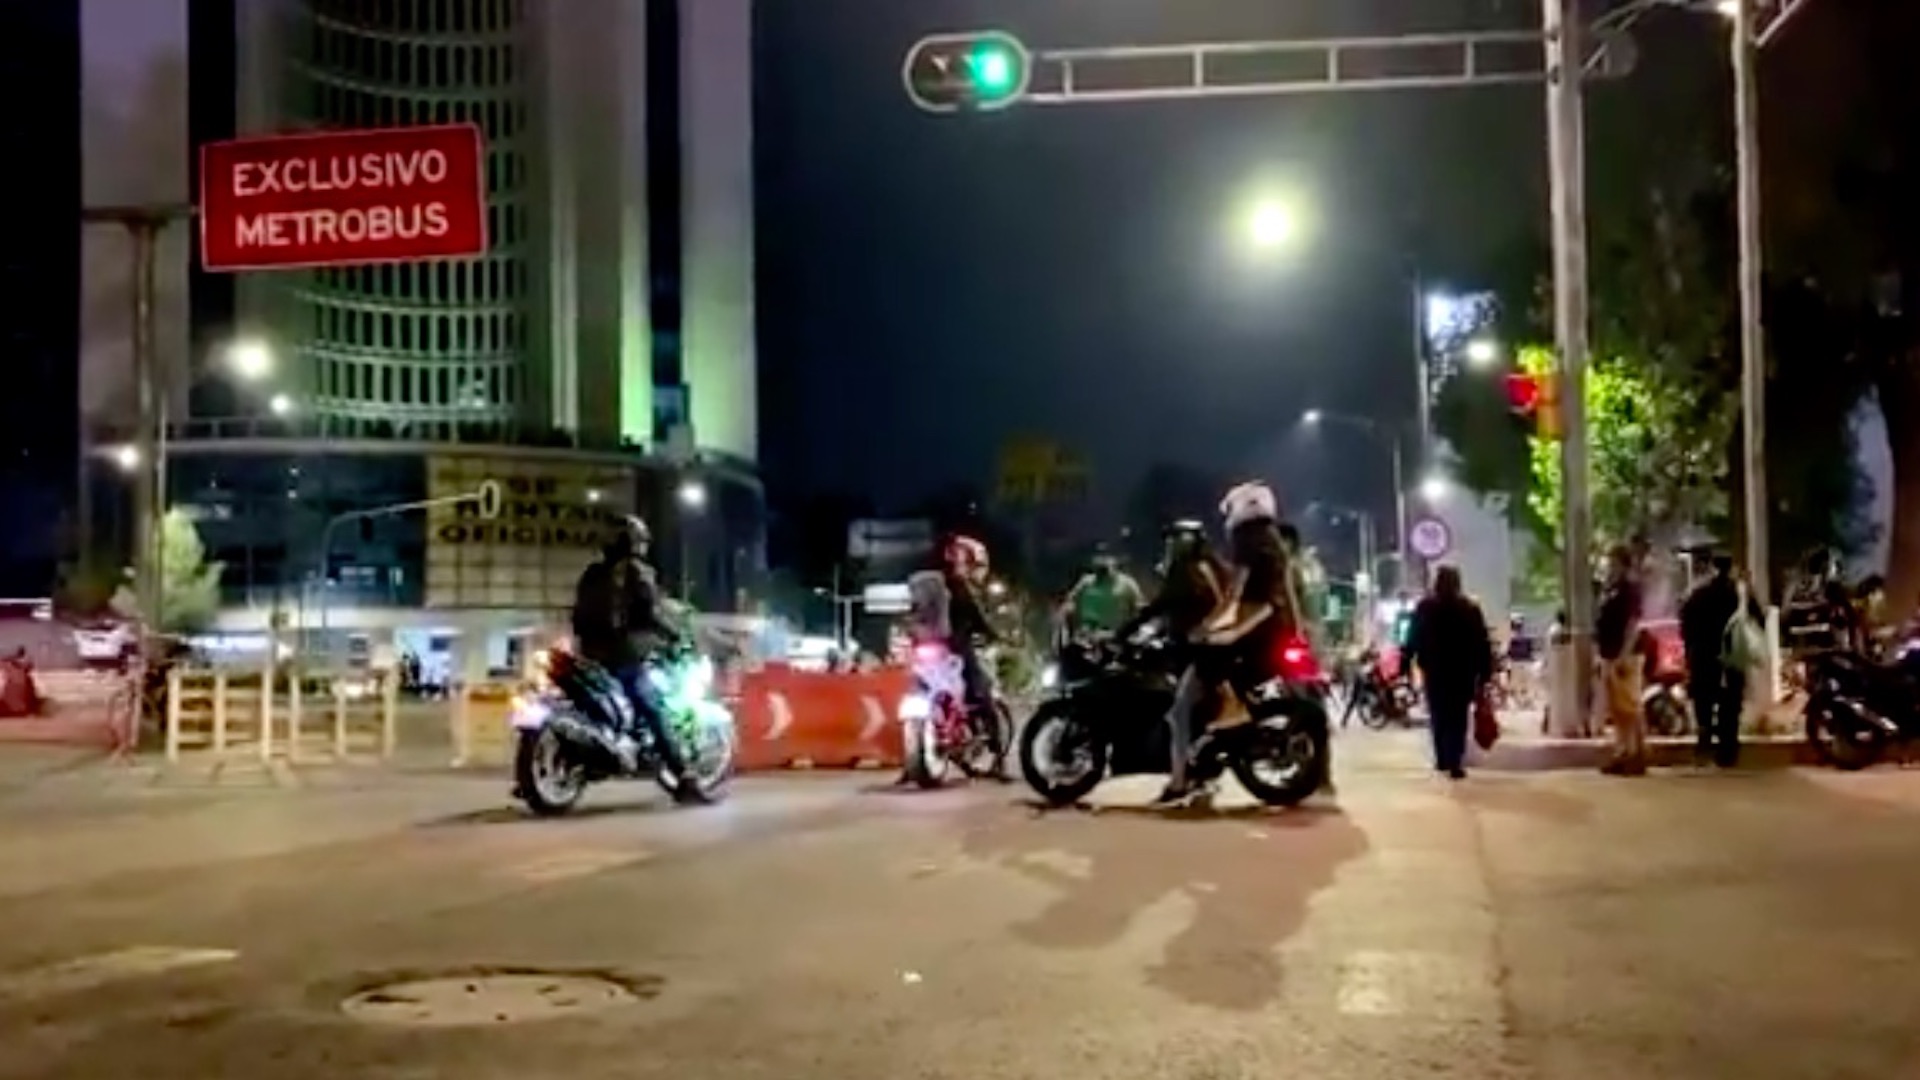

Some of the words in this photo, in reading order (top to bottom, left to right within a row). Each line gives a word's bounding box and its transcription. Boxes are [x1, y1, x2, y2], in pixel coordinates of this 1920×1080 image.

[232, 149, 447, 197] EXCLUSIVO
[234, 202, 449, 248] METROBUS
[438, 523, 616, 545] OFICINA
